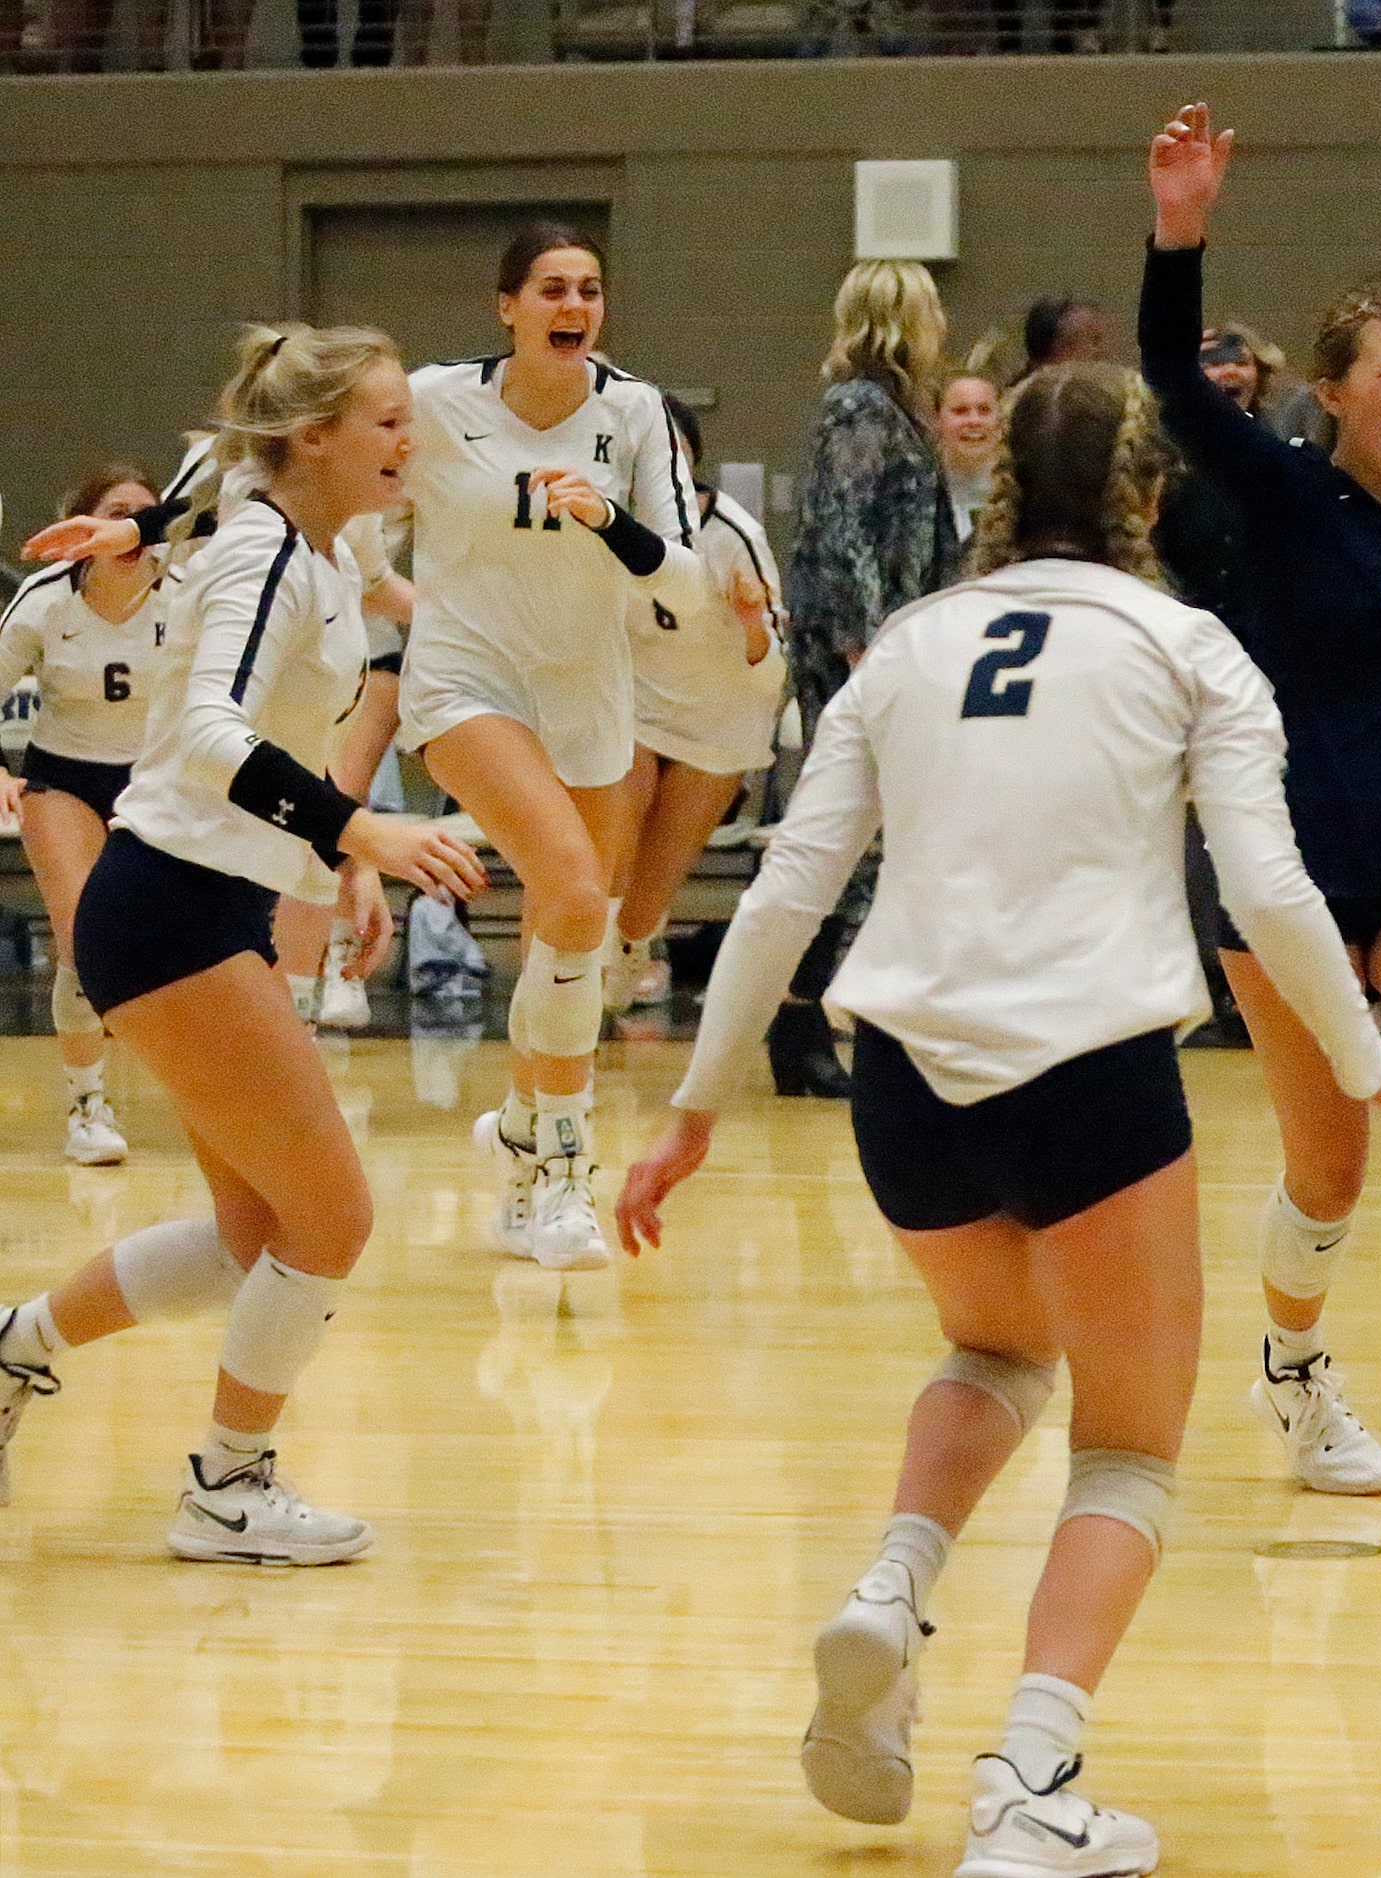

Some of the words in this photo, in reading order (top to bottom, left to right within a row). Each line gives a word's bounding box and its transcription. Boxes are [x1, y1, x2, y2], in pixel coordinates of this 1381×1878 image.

[594, 433, 613, 464] K
[104, 662, 131, 702] 6
[961, 611, 1052, 719] 2
